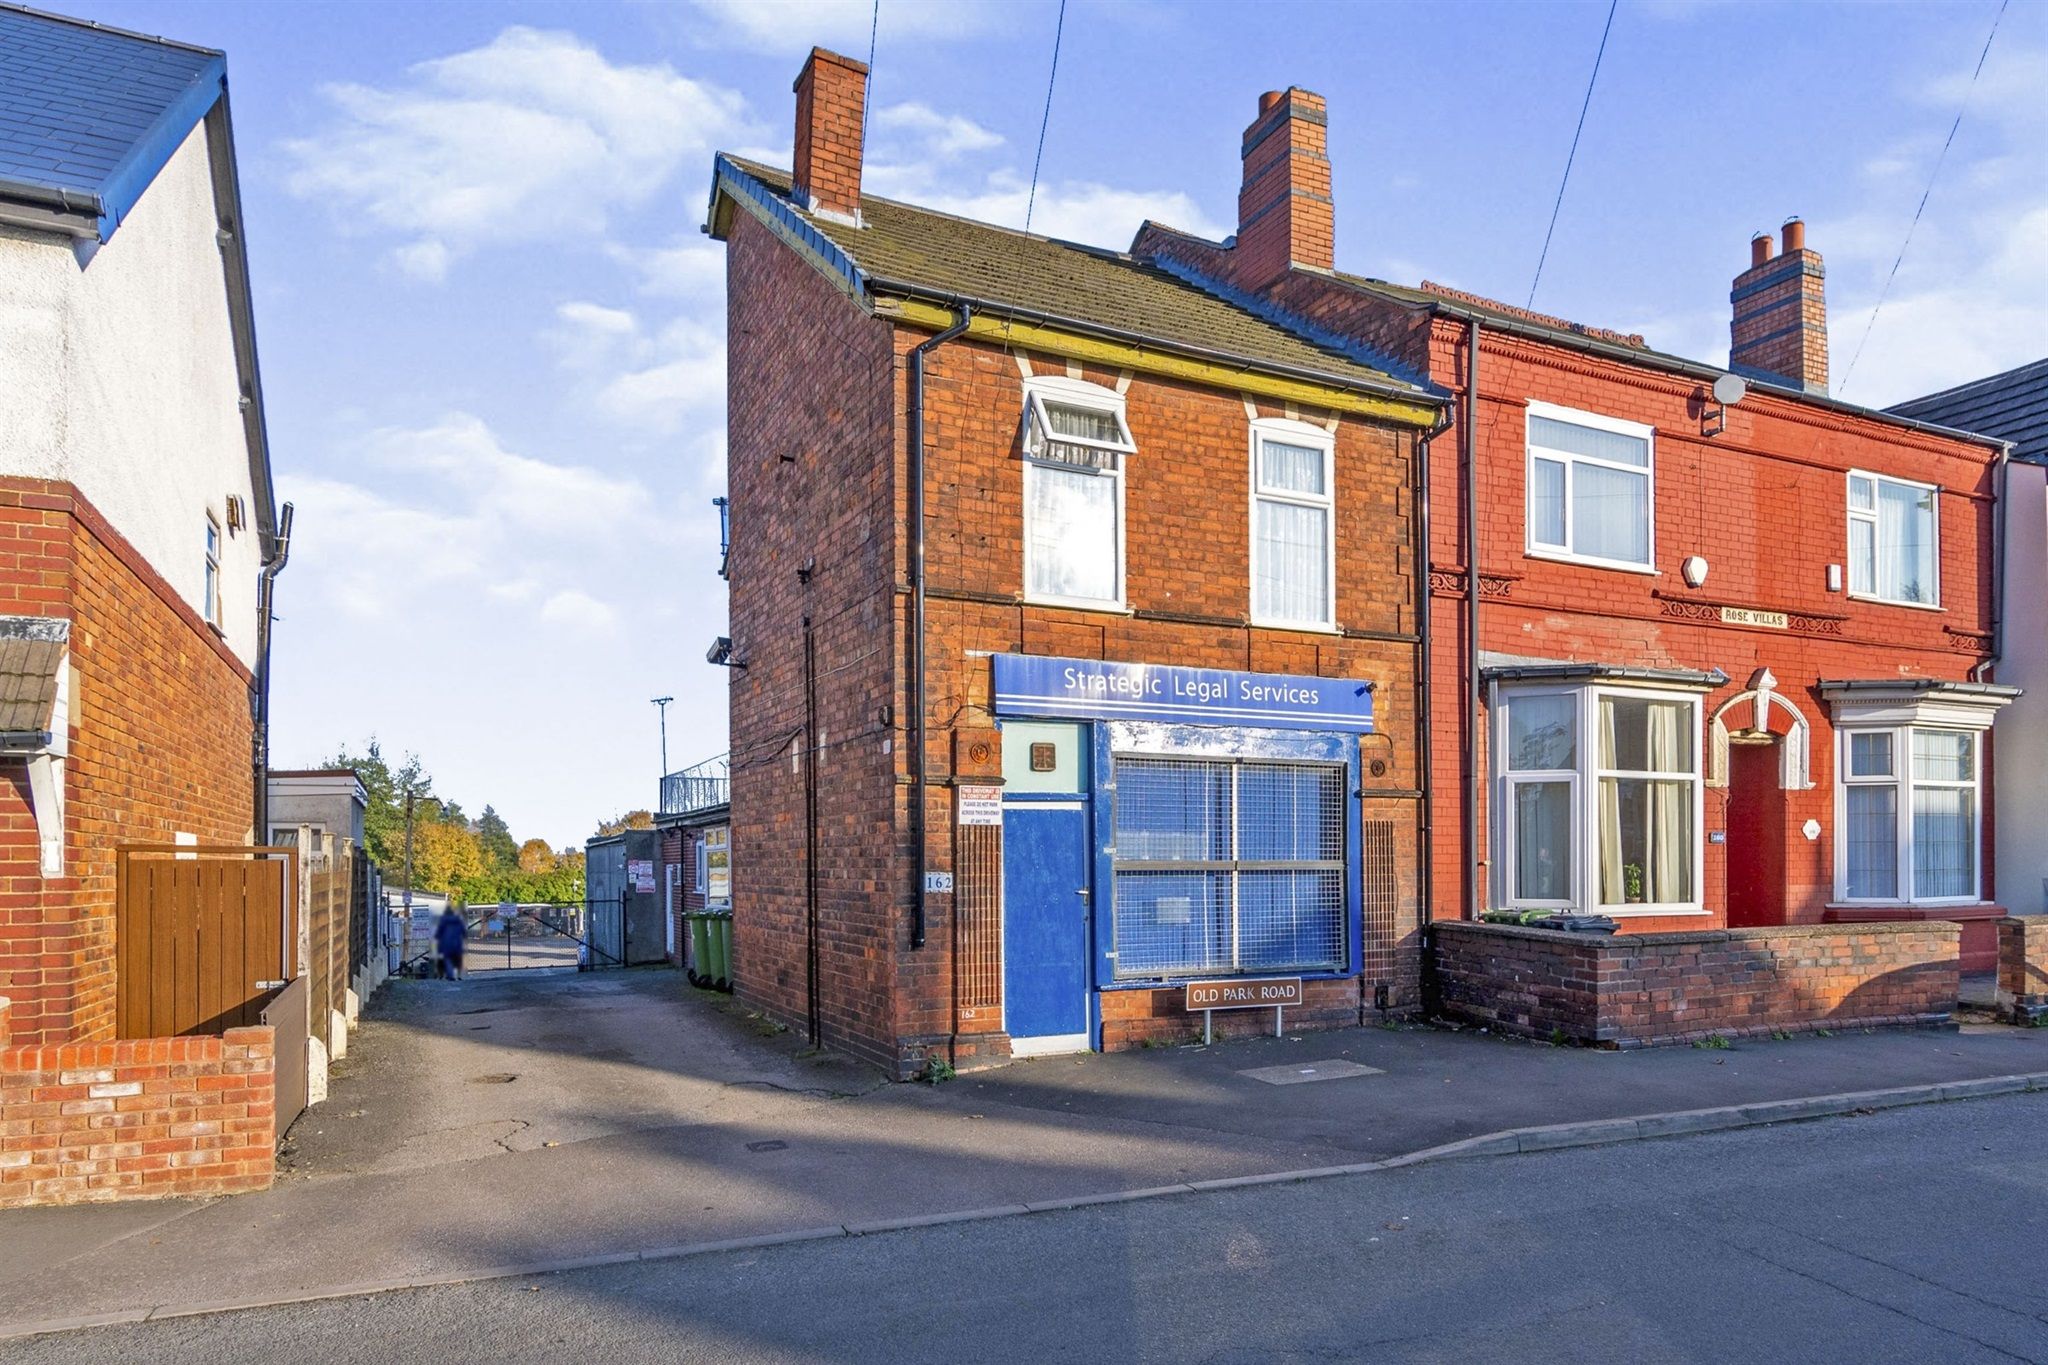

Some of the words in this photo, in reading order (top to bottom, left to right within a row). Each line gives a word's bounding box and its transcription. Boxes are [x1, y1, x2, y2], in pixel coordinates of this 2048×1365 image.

[1725, 609, 1749, 622] ROSE
[1753, 612, 1784, 626] VILLAS
[1064, 667, 1162, 699] Strategic
[1175, 675, 1228, 703] Legal
[1241, 680, 1319, 705] Services
[927, 876, 952, 889] 162
[1192, 988, 1219, 1003] OLD
[1223, 986, 1255, 1001] PARK
[1261, 985, 1296, 999] ROAD
[961, 1009, 976, 1019] 162
